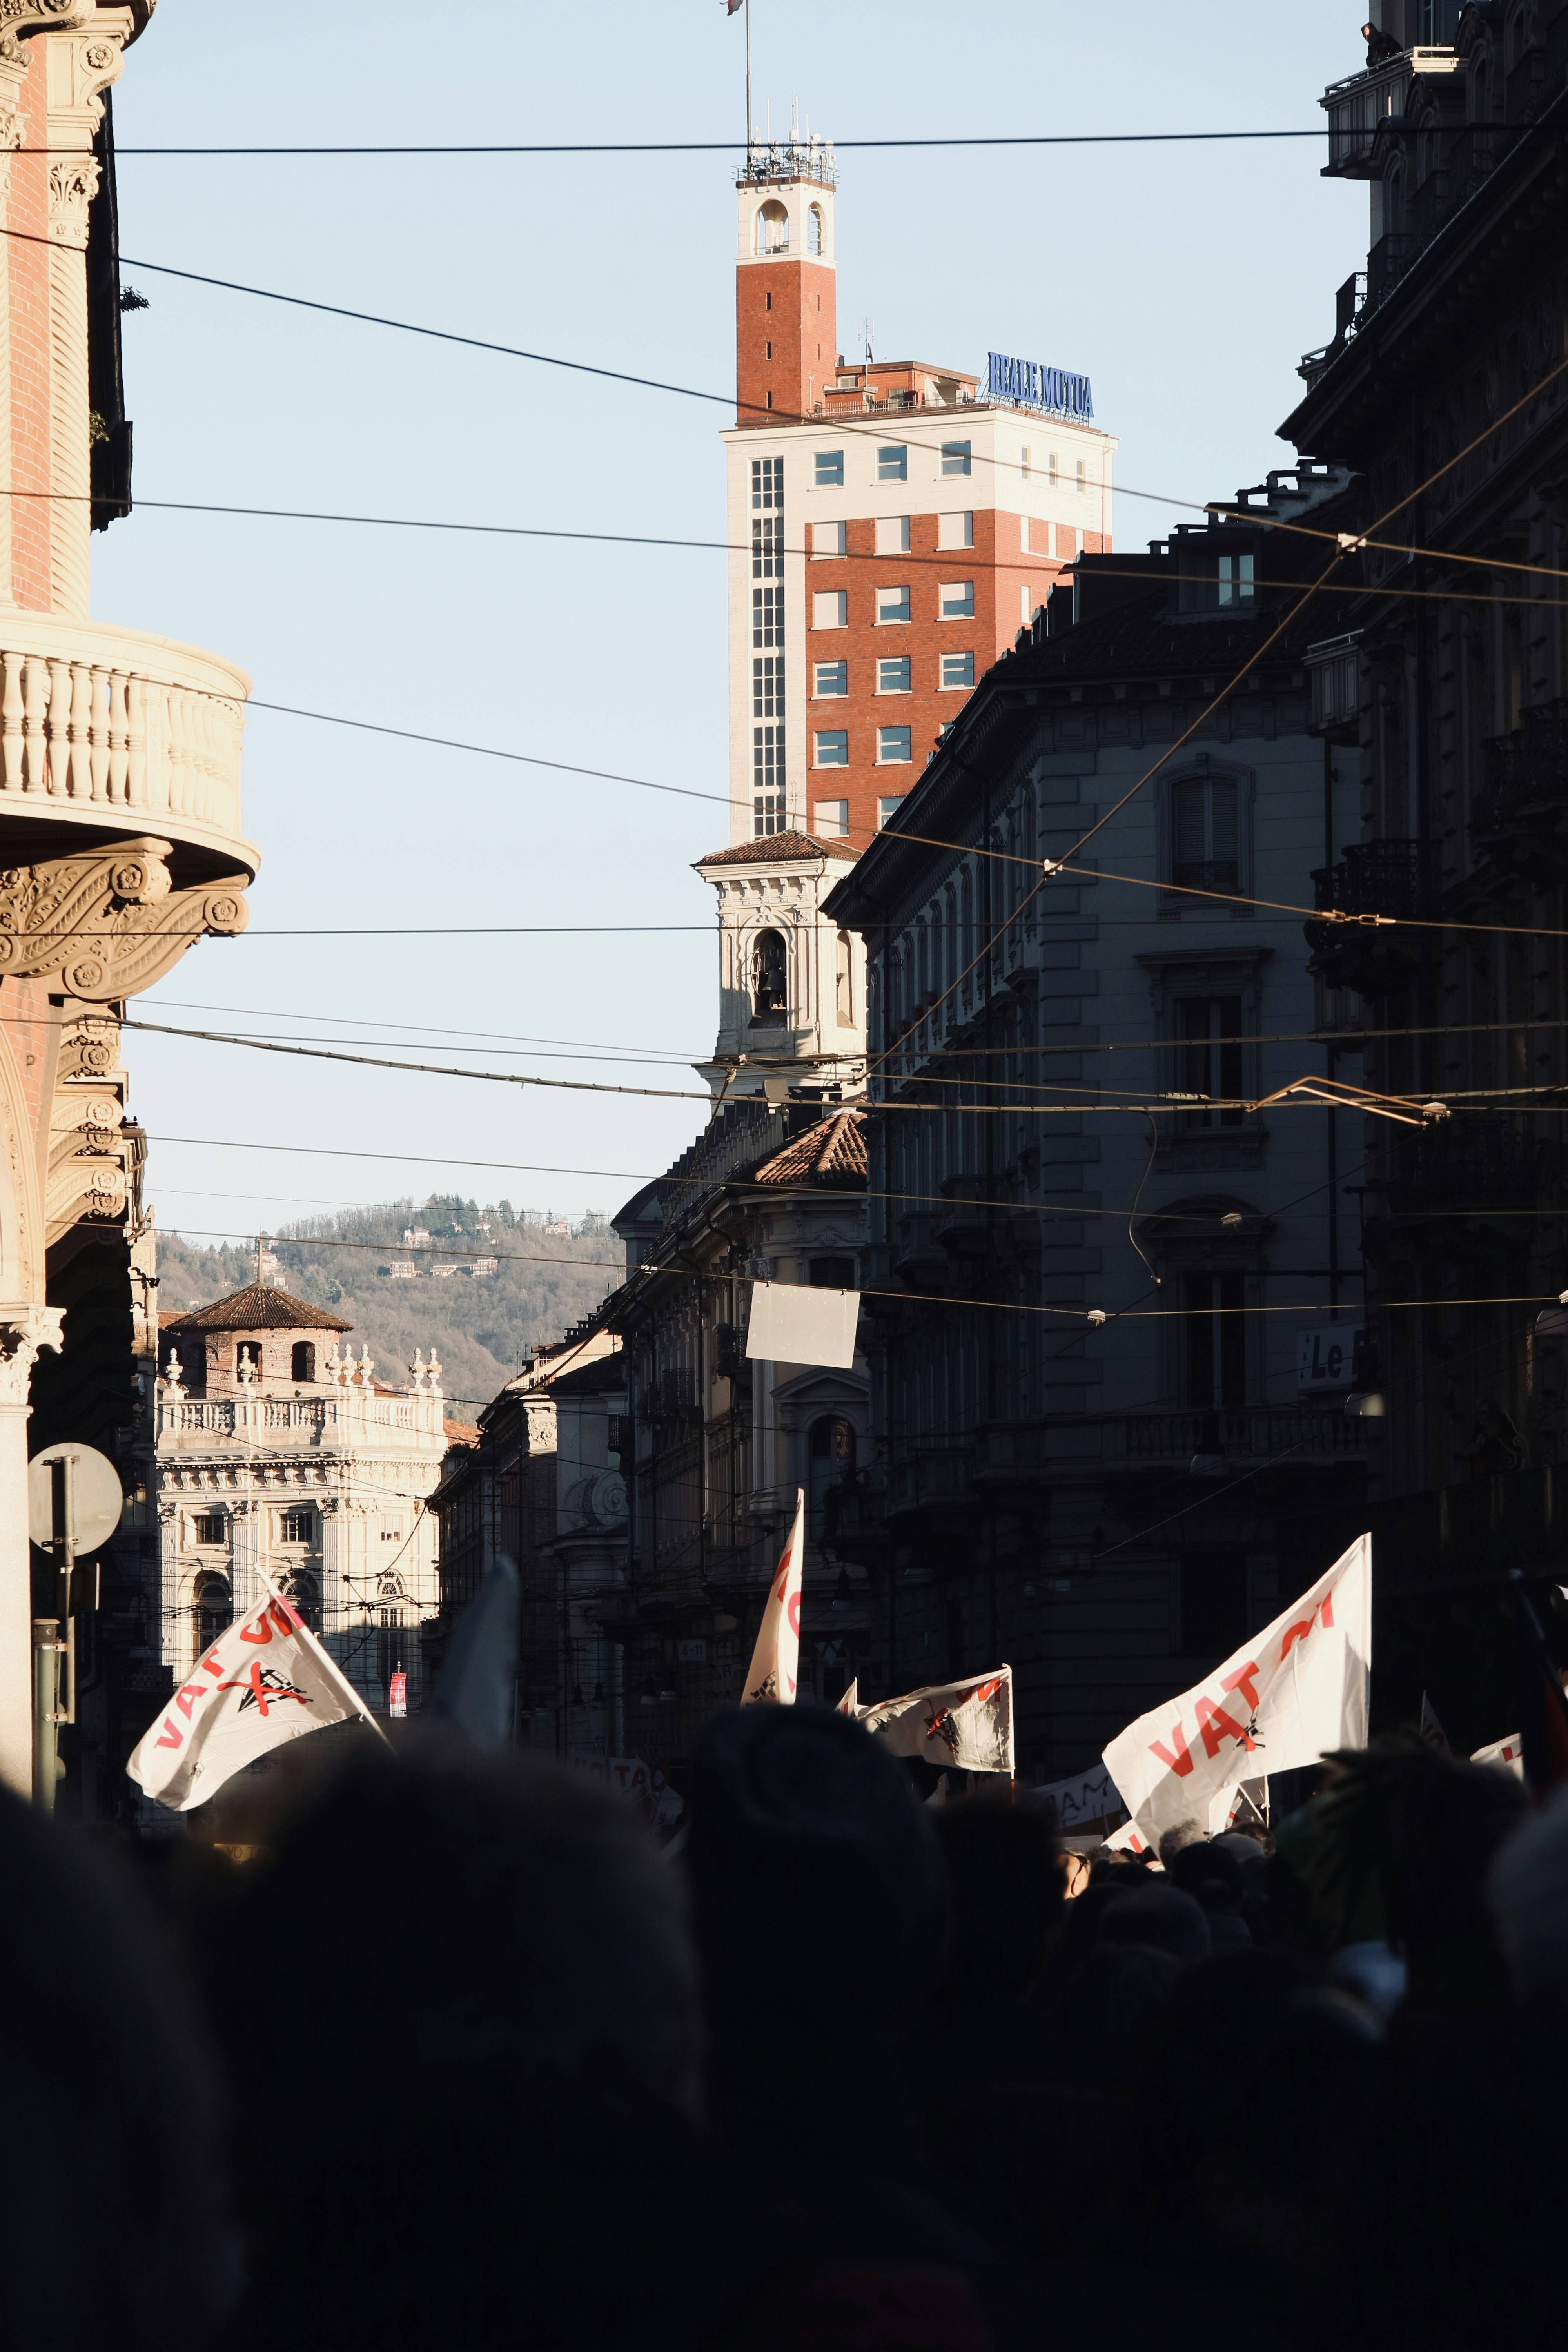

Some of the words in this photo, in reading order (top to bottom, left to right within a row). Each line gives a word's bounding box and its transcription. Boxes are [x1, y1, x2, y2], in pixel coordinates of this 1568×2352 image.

[988, 352, 1038, 403] REALE
[1039, 365, 1094, 418] MUTUA
[1312, 1334, 1343, 1379] Le
